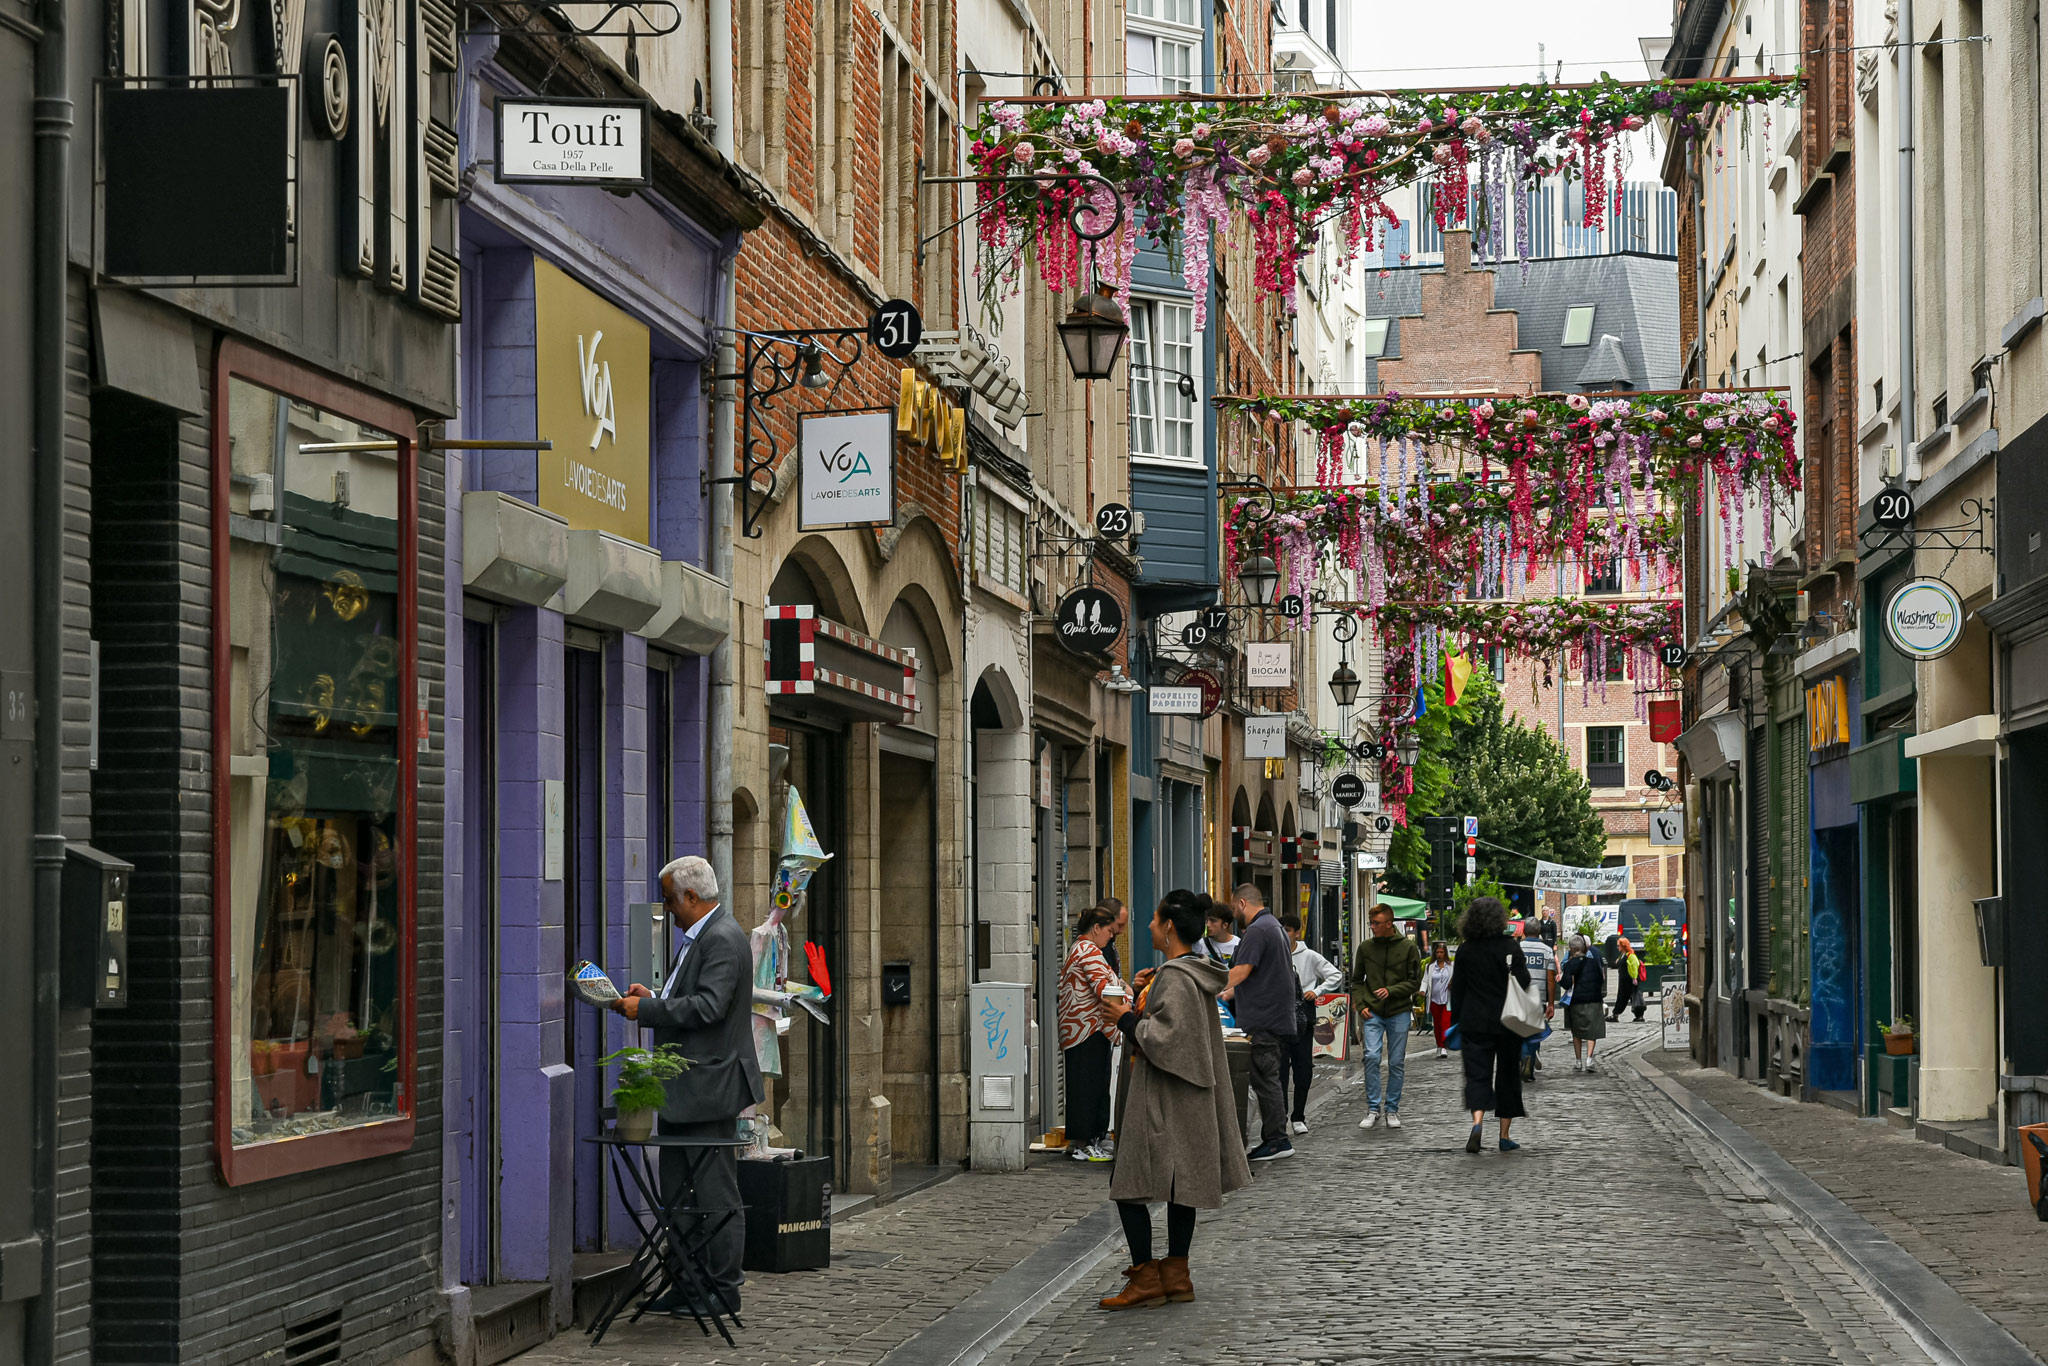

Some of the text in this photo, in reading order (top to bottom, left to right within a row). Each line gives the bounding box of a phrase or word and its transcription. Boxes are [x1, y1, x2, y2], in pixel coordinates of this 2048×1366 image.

[521, 111, 624, 147] Toufi
[562, 150, 584, 159] 1957
[532, 160, 613, 173] Casa Della Pelle
[878, 310, 912, 348] 31
[1879, 495, 1910, 520] 20
[1100, 509, 1128, 532] 23
[1284, 600, 1300, 615] 15
[1209, 612, 1227, 628] 17
[1896, 609, 1952, 630] Washington
[1062, 621, 1117, 637] Opie Omie
[1187, 626, 1207, 645] 19
[1665, 647, 1682, 663] 12
[1251, 667, 1287, 675] BIOCAM
[1197, 671, 1217, 689] CLOVER
[9, 690, 26, 721] 35
[1152, 700, 1198, 708] PAPERITO
[1247, 725, 1283, 738] Shanghai
[1262, 740, 1268, 750] 7
[1362, 743, 1370, 756] 5
[1375, 746, 1383, 757] 3
[1649, 773, 1657, 784] 6
[1378, 817, 1389, 829] 1A
[1539, 870, 1568, 878] BRUSSELS
[1605, 874, 1625, 883] MARKET
[821, 1182, 832, 1229] EXPO
[778, 1220, 822, 1234] MANGANO
